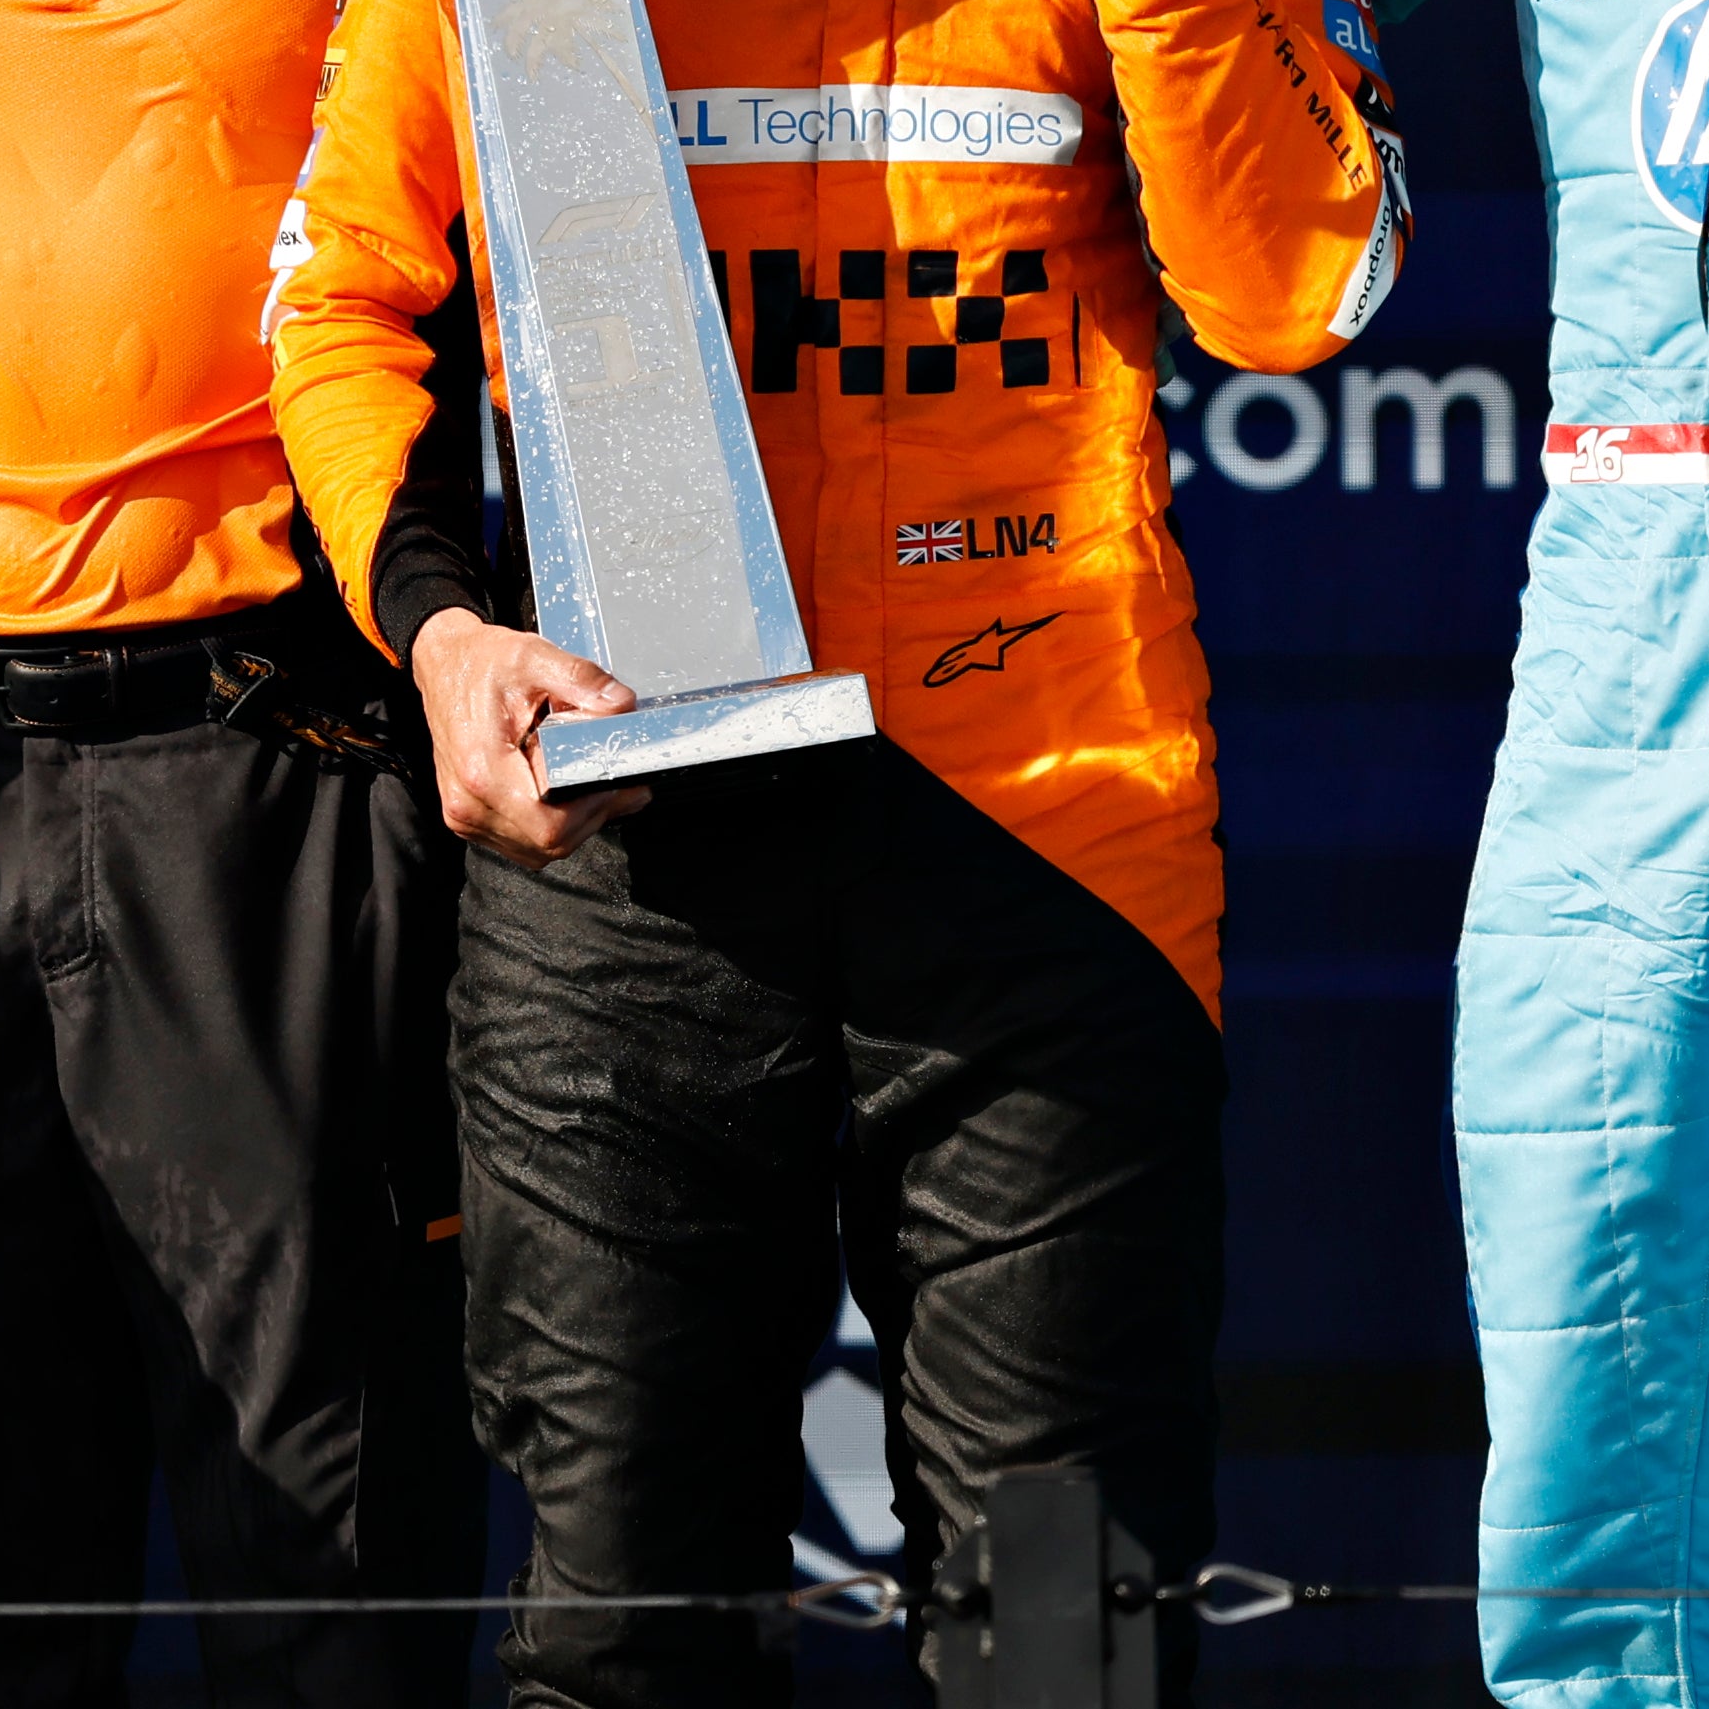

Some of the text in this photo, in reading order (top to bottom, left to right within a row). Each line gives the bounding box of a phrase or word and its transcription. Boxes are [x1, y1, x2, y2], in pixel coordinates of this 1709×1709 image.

[737, 96, 1062, 155] Technologies
[1306, 91, 1367, 192] MILLE
[1350, 205, 1391, 327] Dropbox
[1569, 426, 1631, 483] 16
[965, 512, 1059, 559] LN4
